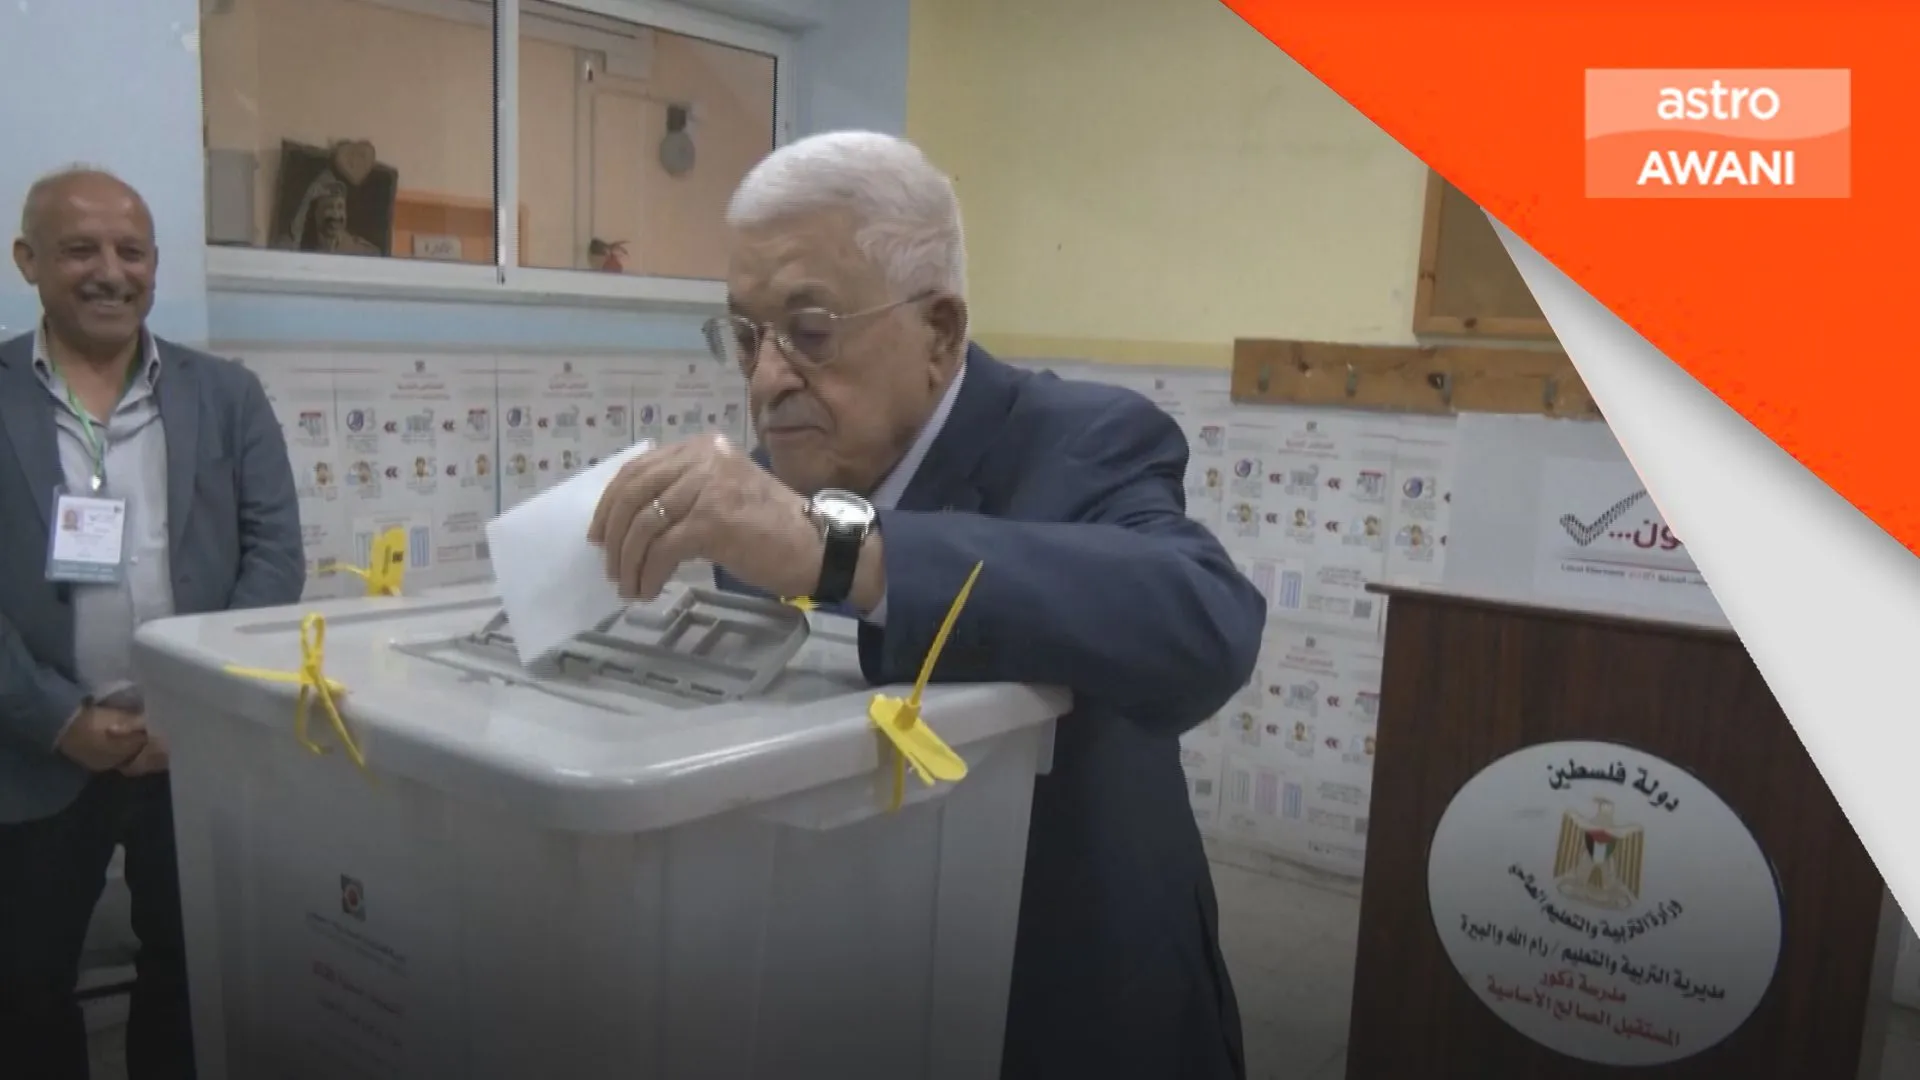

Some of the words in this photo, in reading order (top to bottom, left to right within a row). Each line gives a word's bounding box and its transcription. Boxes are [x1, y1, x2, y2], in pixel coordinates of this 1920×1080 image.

[1546, 758, 1626, 790] فلسطين
[1633, 767, 1679, 812] دولة
[1541, 903, 1598, 938] والتعليم
[1646, 899, 1683, 927] وزارة
[1460, 914, 1504, 946] والبيرة
[1506, 924, 1527, 948] الله
[1602, 917, 1649, 944] التربية
[1528, 937, 1549, 958] رام
[1562, 944, 1617, 975] والتعليم
[1621, 954, 1670, 986] التربية
[1673, 968, 1726, 1001] مديرية
[1578, 972, 1627, 1003] مدرسة
[1614, 1016, 1681, 1048] المستقبل
